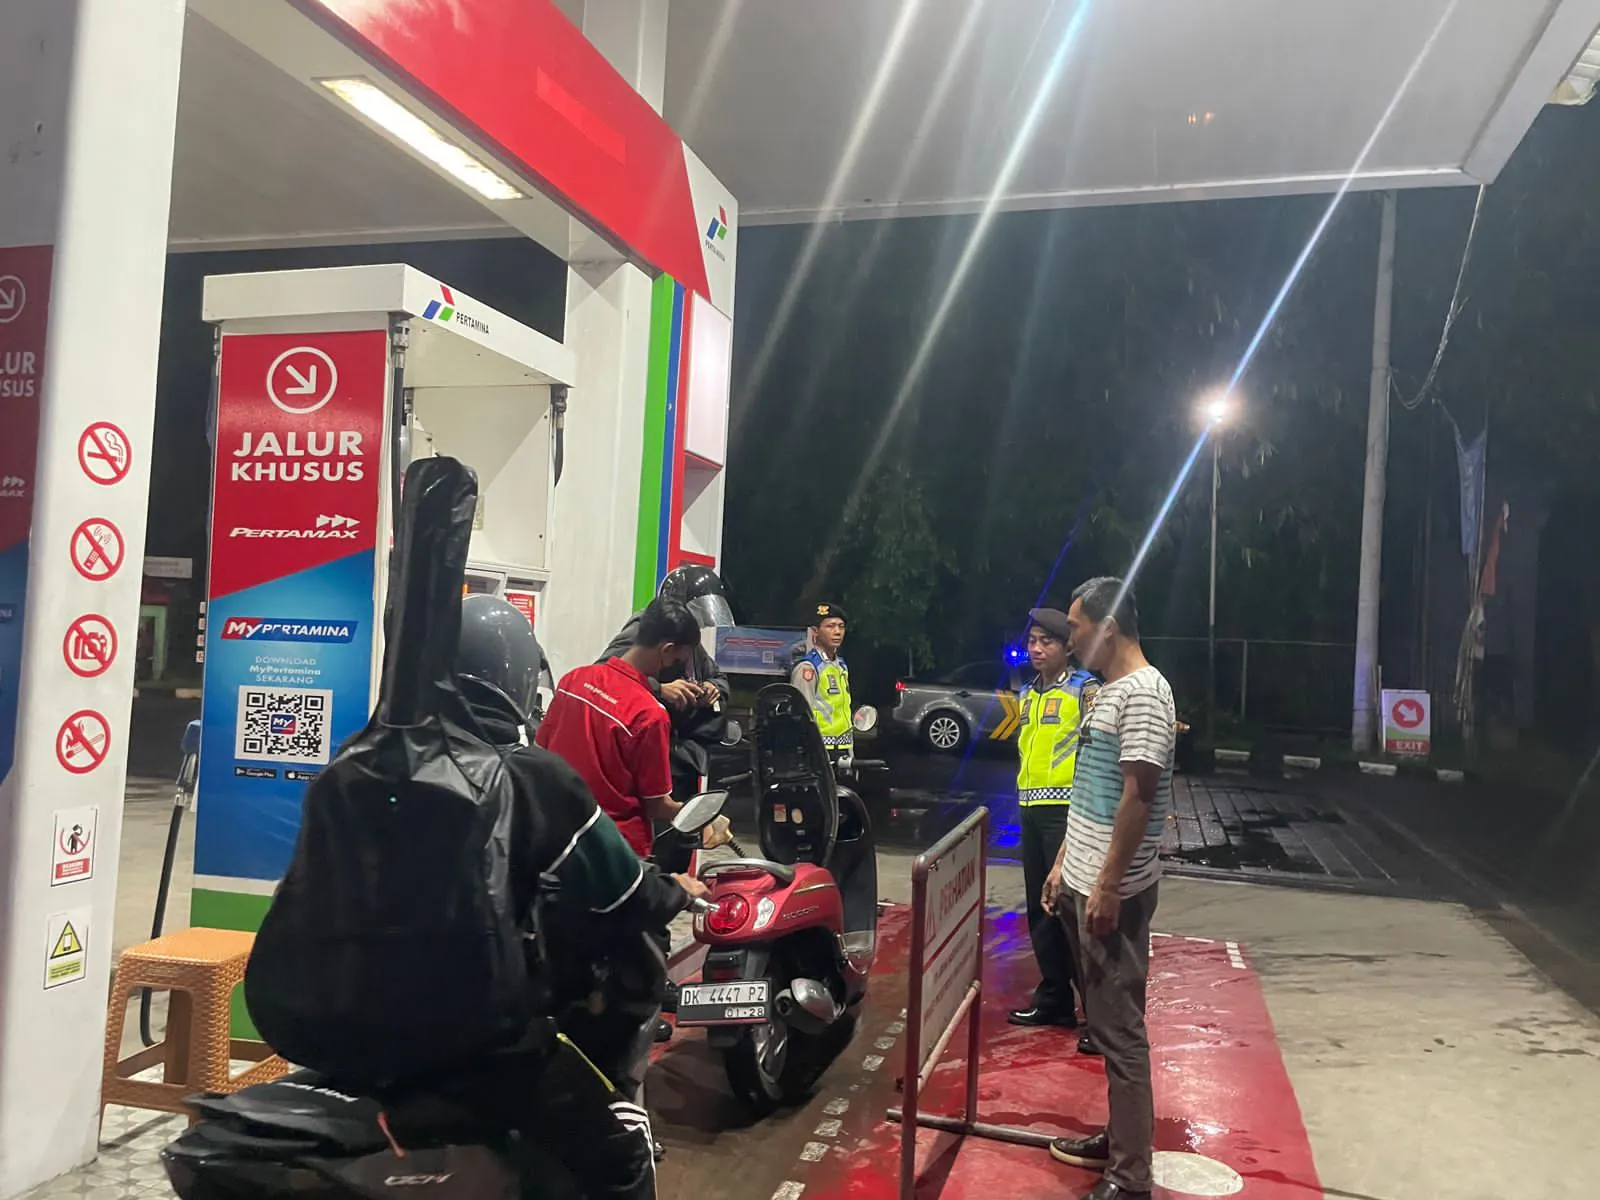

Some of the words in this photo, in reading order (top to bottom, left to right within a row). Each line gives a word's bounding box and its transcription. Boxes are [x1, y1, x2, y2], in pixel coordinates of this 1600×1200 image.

[457, 311, 489, 334] PERTAMINA
[0, 351, 36, 374] UR
[233, 431, 364, 457] JALUR
[231, 461, 364, 481] KHUSUS
[229, 527, 359, 539] PERTAMAX
[255, 655, 317, 666] DOWNLOAD
[249, 664, 321, 676] MyPertamina
[255, 674, 314, 685] SEKARANG
[1396, 741, 1423, 751] EXIT
[684, 989, 700, 1005] DK
[709, 987, 741, 1003] 4447
[748, 986, 765, 1001] PZ
